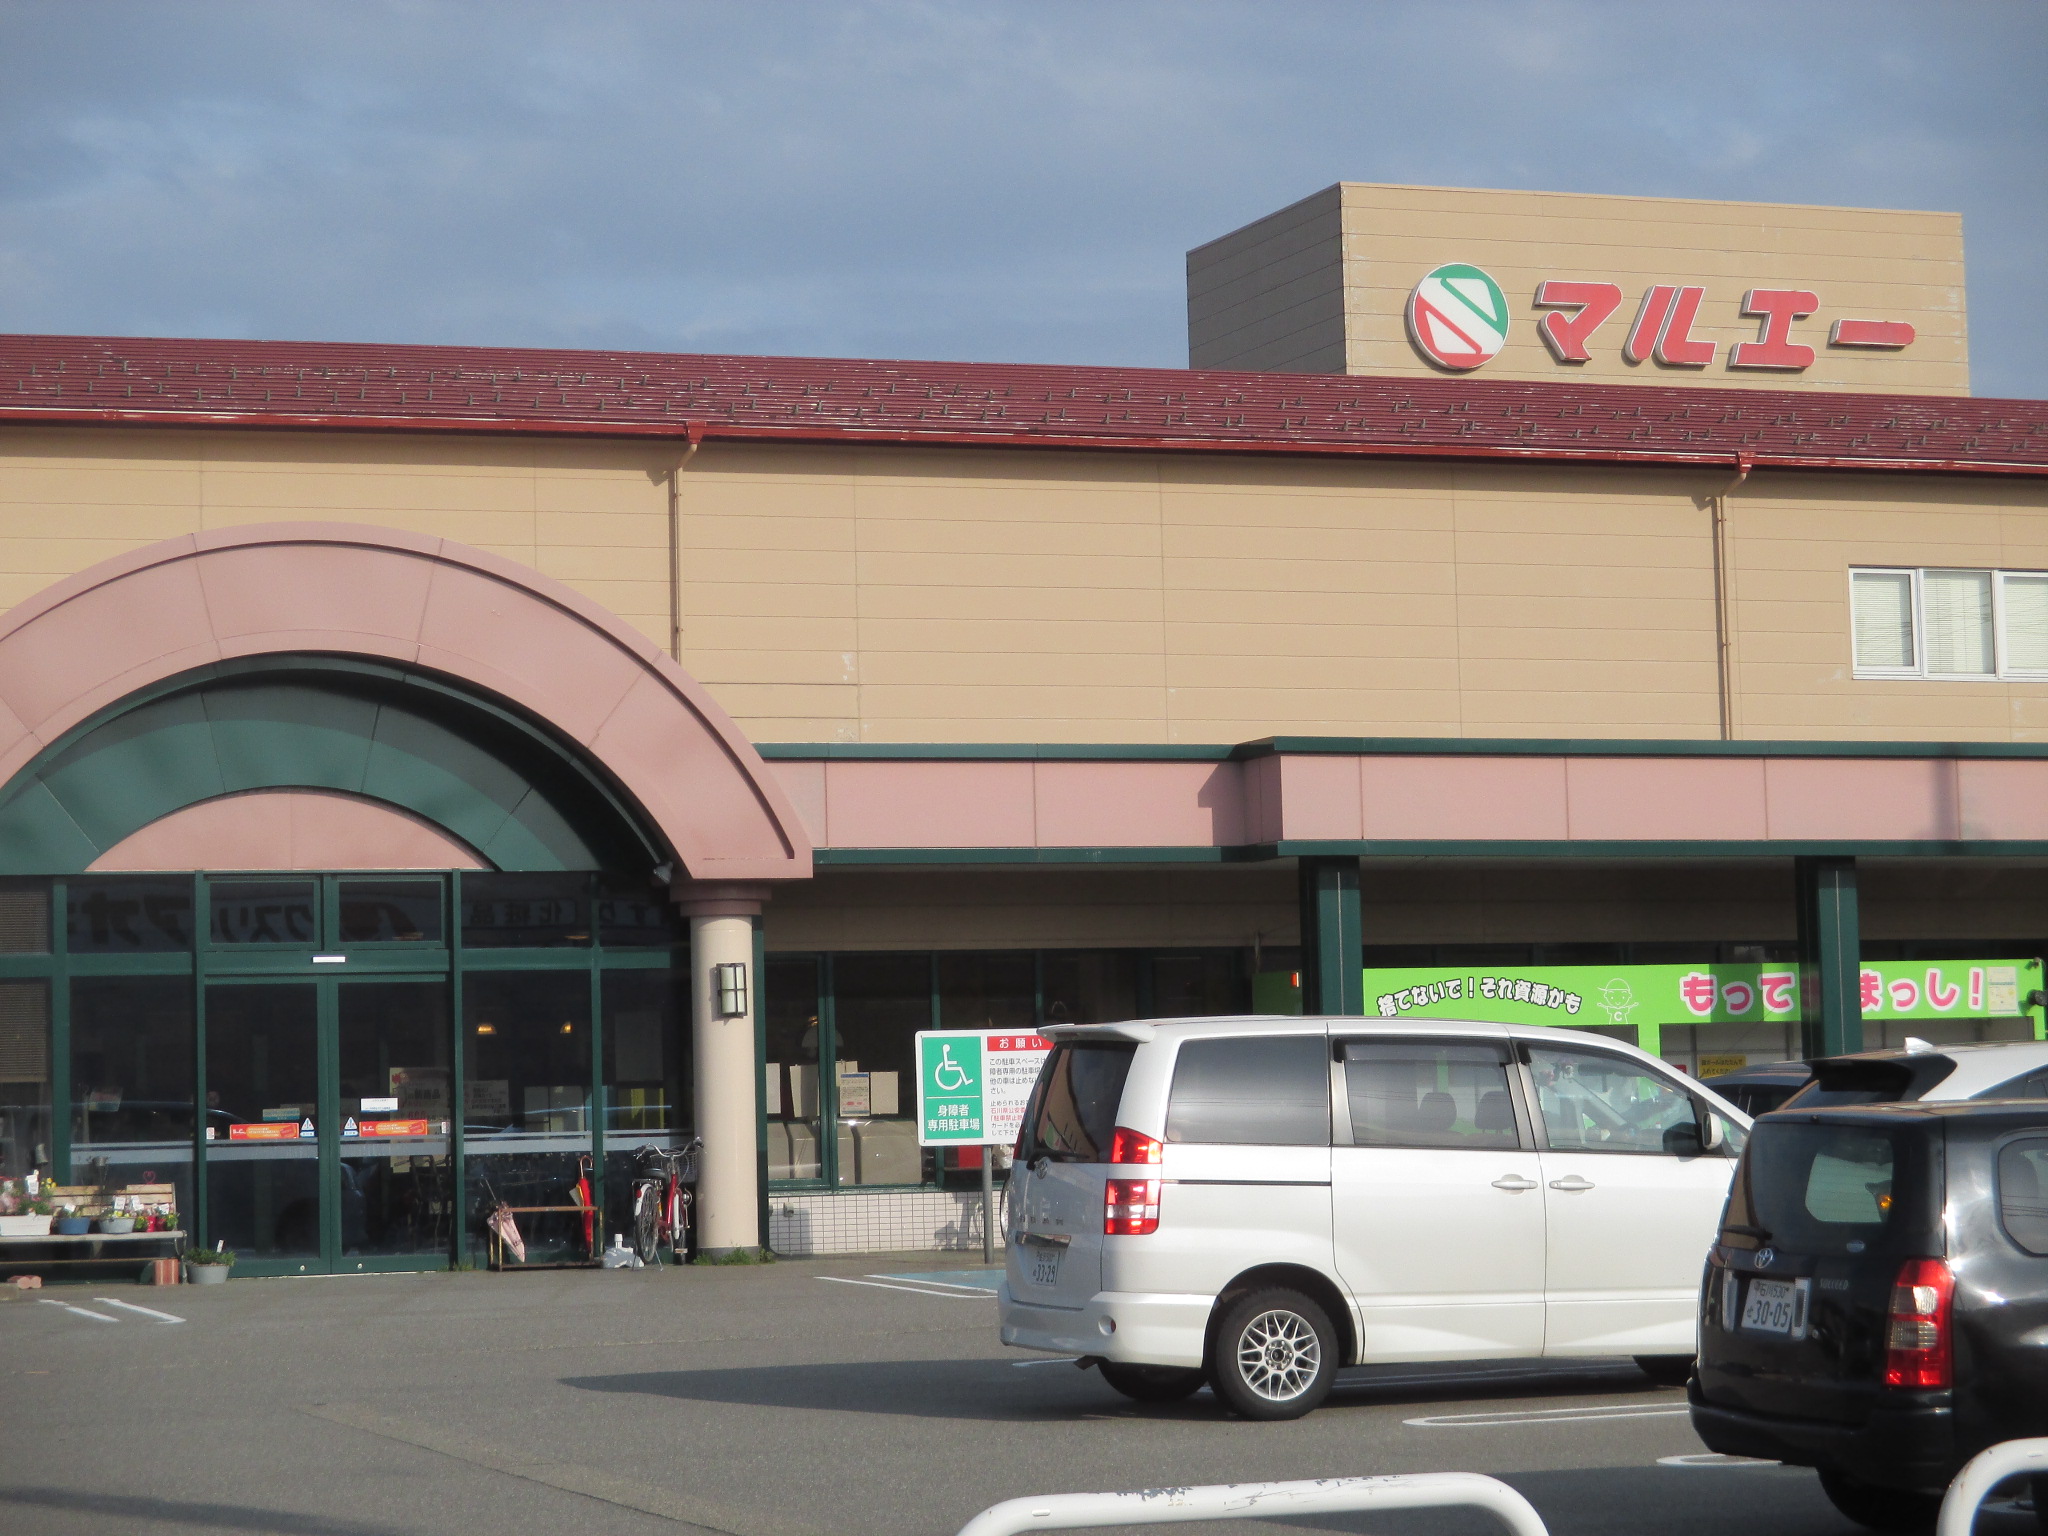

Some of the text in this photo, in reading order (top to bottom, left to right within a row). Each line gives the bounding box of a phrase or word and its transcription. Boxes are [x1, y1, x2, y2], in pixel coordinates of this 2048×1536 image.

[1534, 280, 1916, 368] マルエー
[999, 1037, 1043, 1049] お願い
[937, 1104, 970, 1117] 身障者
[927, 1118, 981, 1132] 専用駐車場
[1753, 1300, 1791, 1328] 30-05
